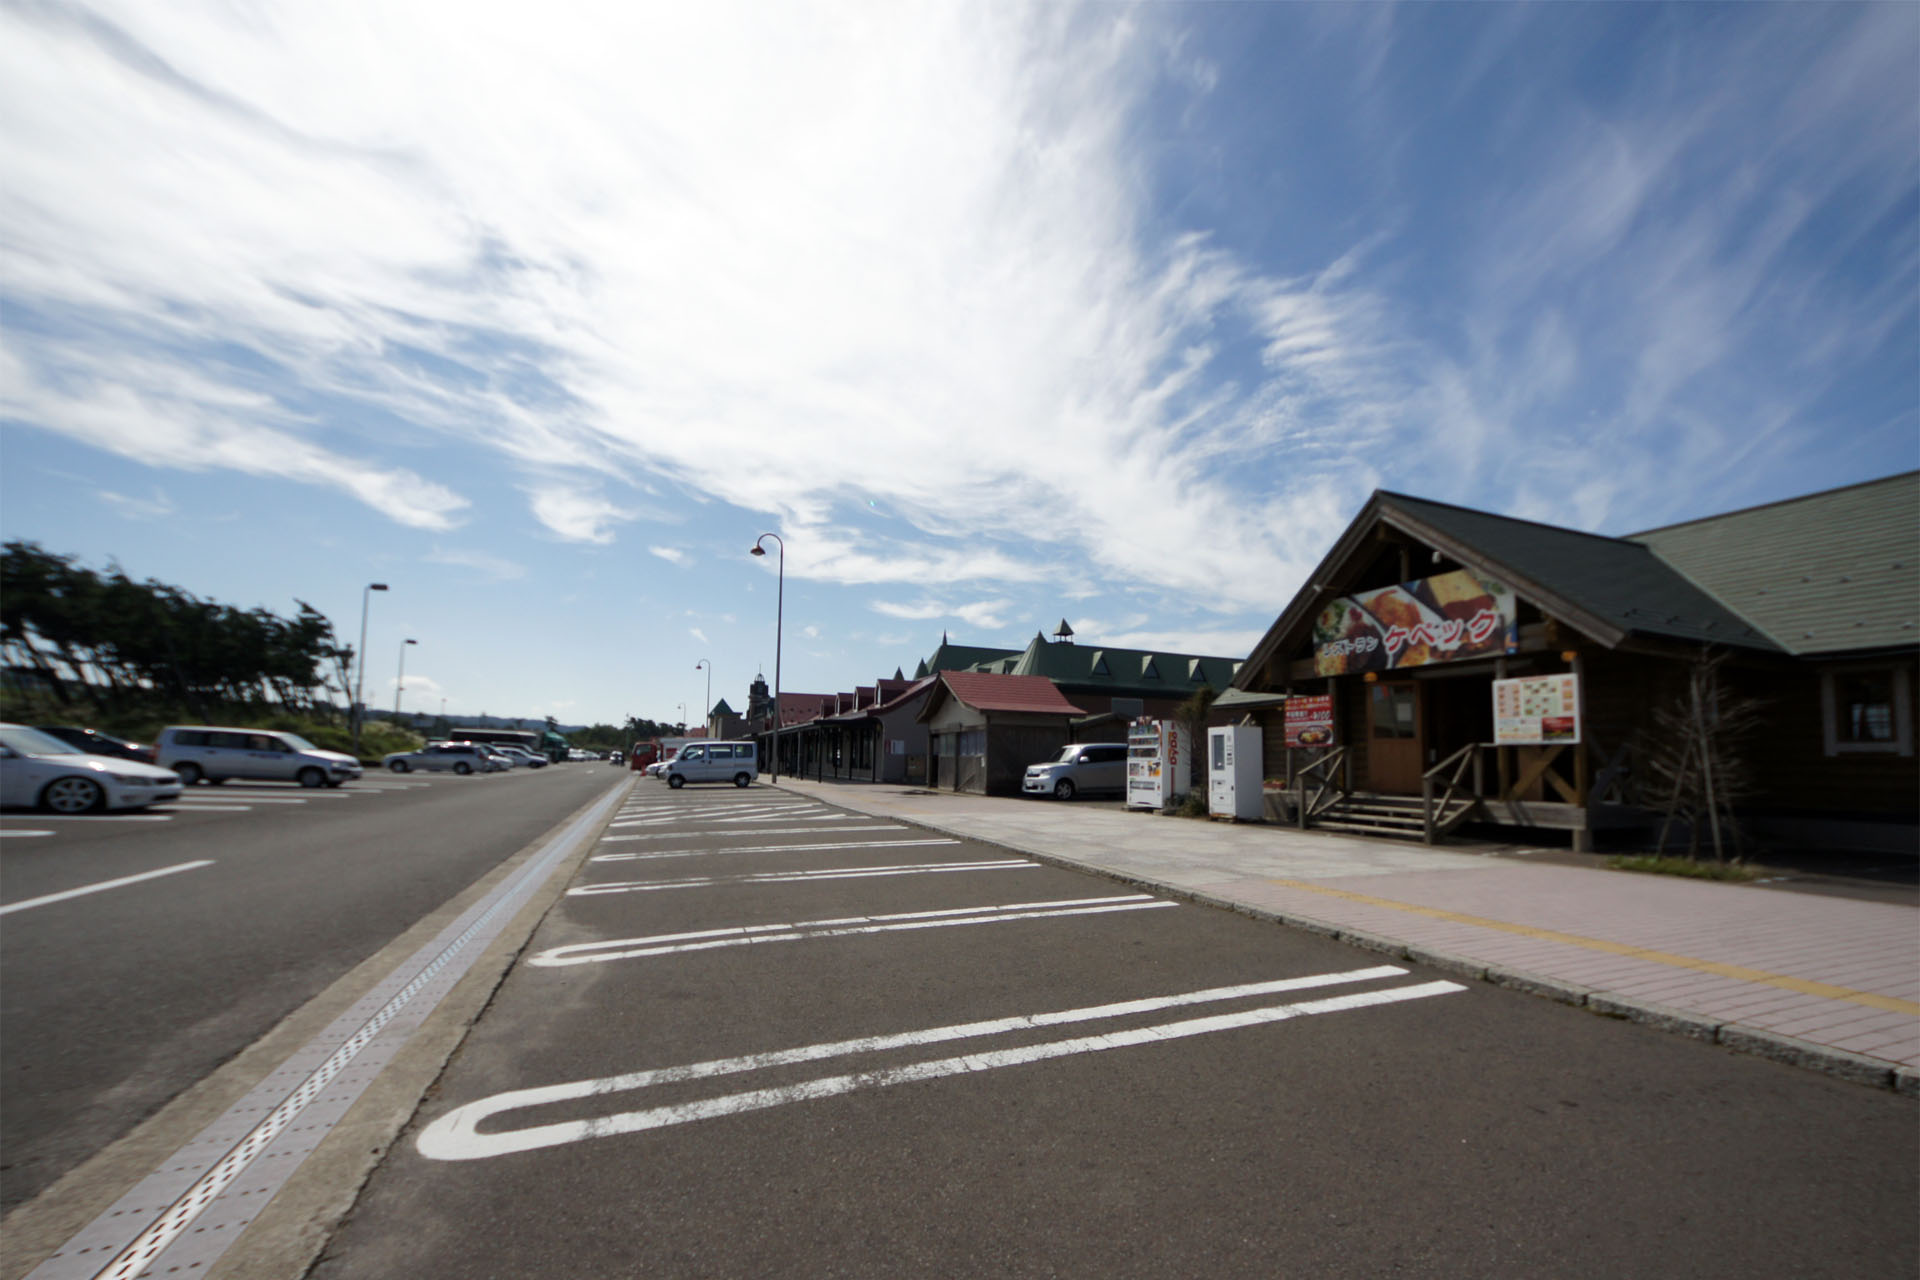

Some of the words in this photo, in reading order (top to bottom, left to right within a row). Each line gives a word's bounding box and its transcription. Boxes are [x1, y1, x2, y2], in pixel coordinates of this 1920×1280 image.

[1323, 636, 1379, 657] レストラン
